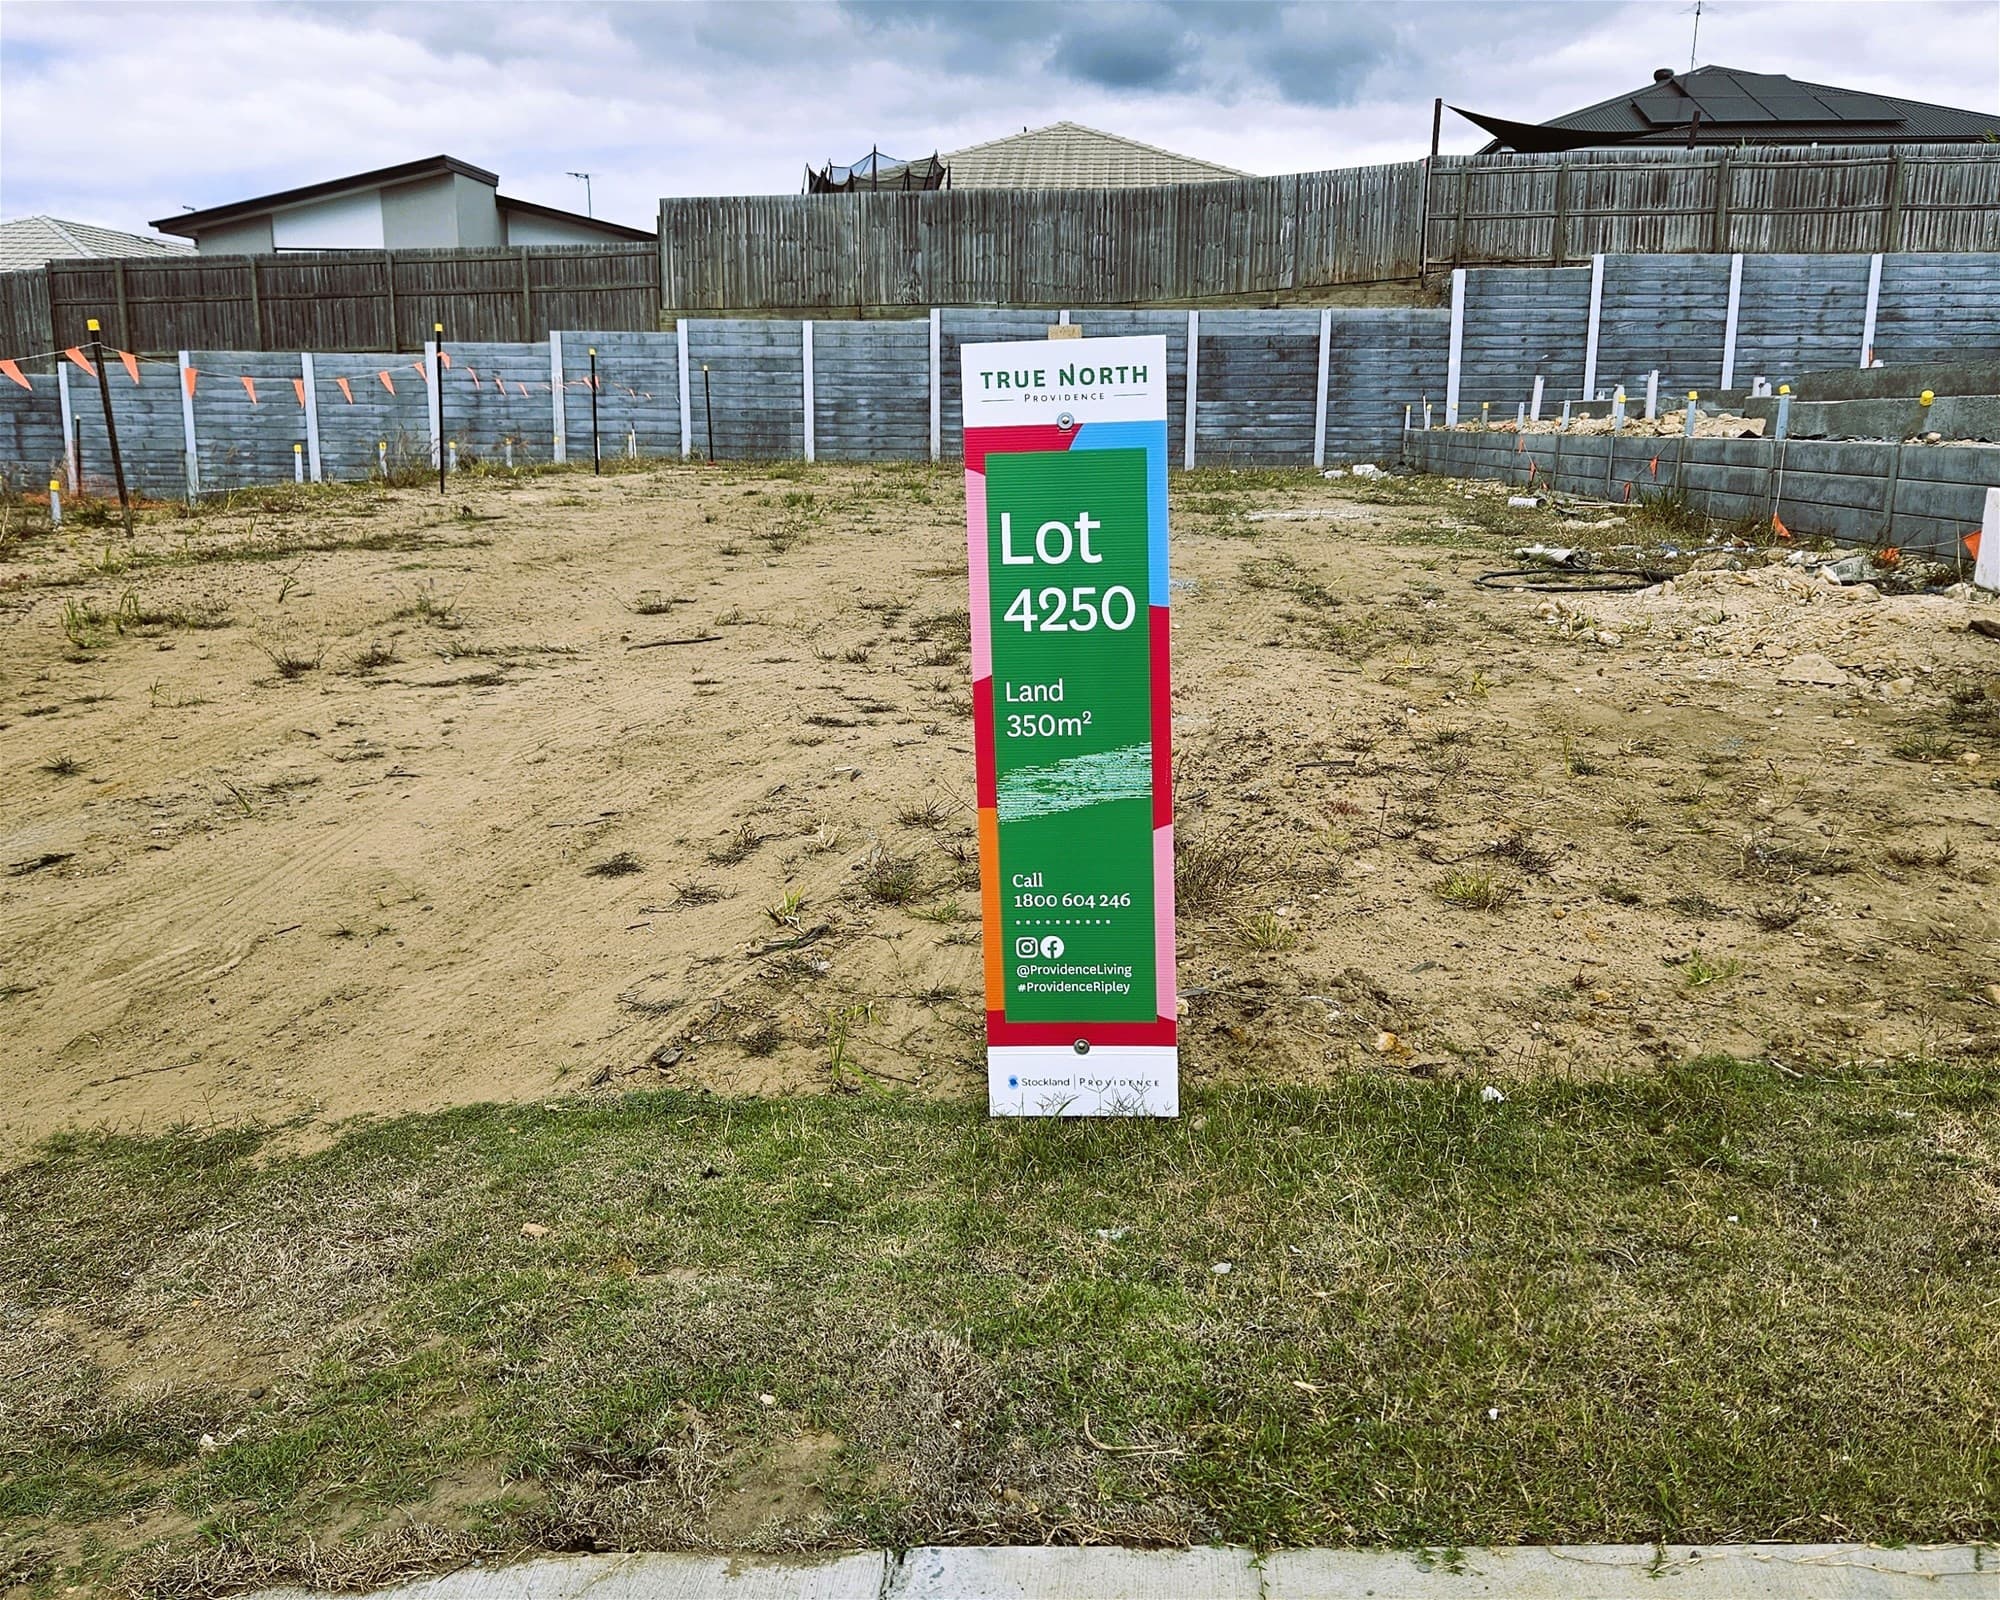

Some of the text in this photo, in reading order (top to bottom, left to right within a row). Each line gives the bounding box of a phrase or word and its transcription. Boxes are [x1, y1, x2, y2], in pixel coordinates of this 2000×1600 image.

[980, 363, 1148, 389] TRUE NORTH
[1024, 392, 1105, 403] PROVIDENCE
[1001, 512, 1103, 565] Lot
[1003, 585, 1136, 632] 4250
[1005, 678, 1064, 703] Land
[1006, 710, 1093, 738] 350m²
[1012, 872, 1044, 888] Call
[1014, 892, 1131, 909] 1800 604 246
[1016, 963, 1132, 978] @ProvidenceLiving
[1017, 981, 1131, 995] #ProvidenceRipley
[1021, 1077, 1070, 1087] Stockland
